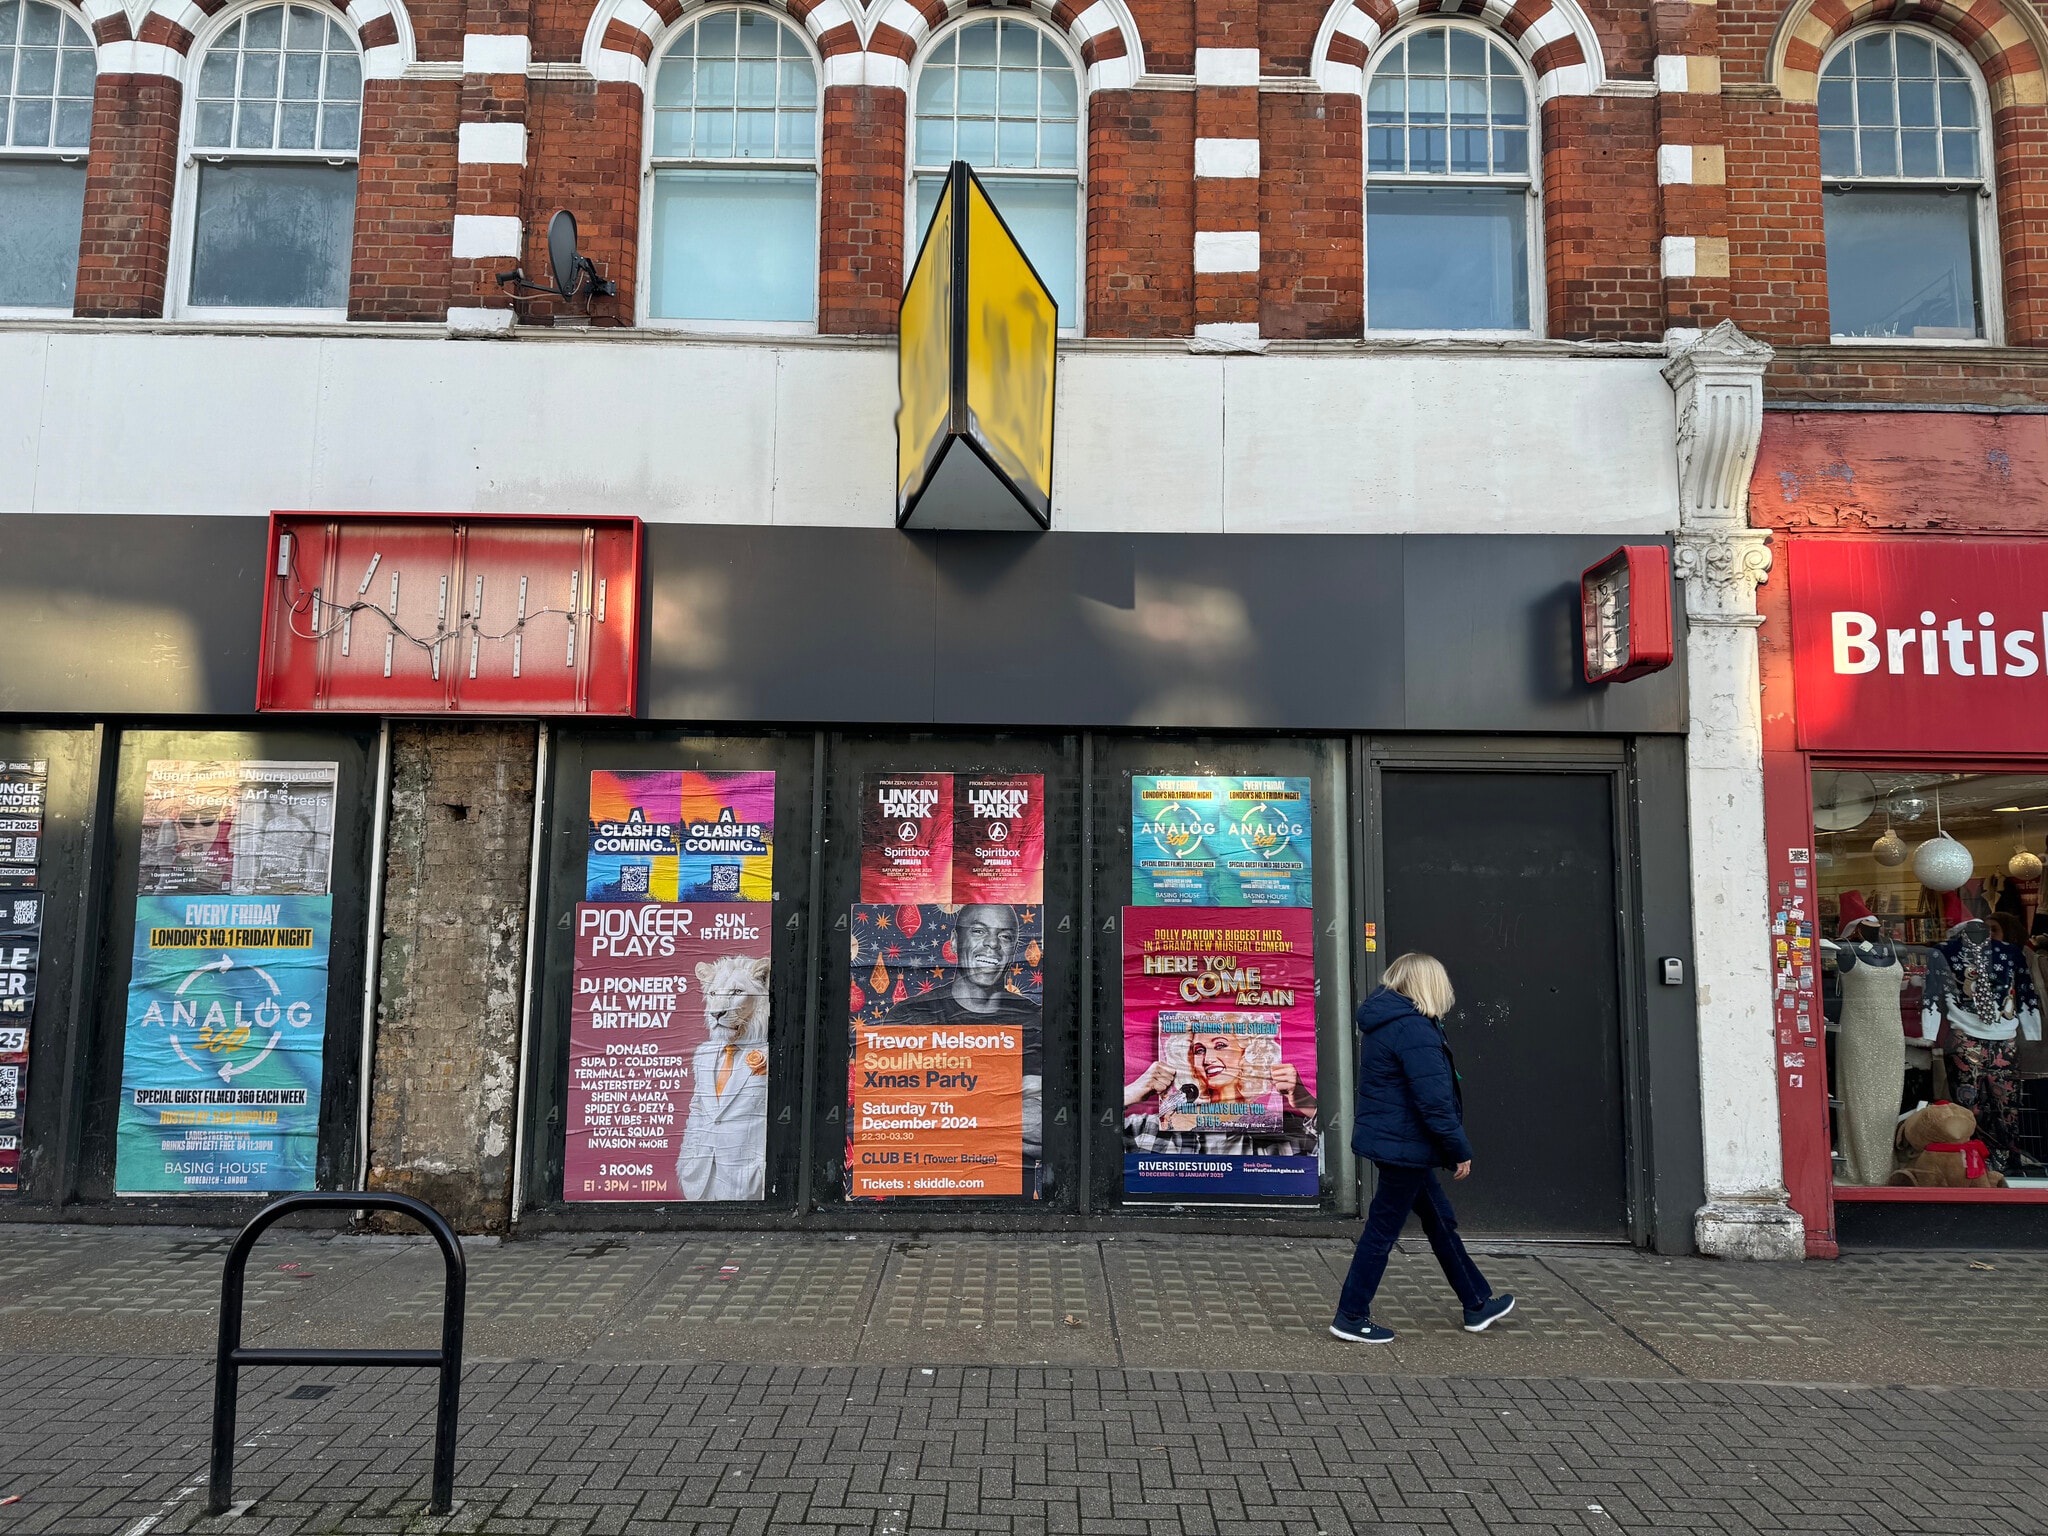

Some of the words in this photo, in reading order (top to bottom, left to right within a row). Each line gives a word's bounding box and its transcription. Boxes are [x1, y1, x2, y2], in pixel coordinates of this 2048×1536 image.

[1831, 611, 2048, 677] Britis
[1157, 780, 1176, 790] EVERY
[1176, 780, 1198, 790] FRIDAY
[1244, 781, 1263, 791] EVERY
[1263, 781, 1285, 791] FRIDAY
[152, 788, 177, 801] Art
[246, 788, 269, 801] Art
[879, 789, 939, 804] LINKIN
[969, 790, 1028, 804] LINKIN
[186, 796, 236, 807] Streets
[279, 796, 328, 807] Streets
[630, 810, 643, 823] A
[720, 810, 732, 823] A
[883, 803, 932, 818] PARK
[973, 803, 1022, 819] PARK
[15, 822, 38, 830] 2025
[600, 825, 653, 837] CLASH
[656, 825, 671, 837] IS
[691, 825, 743, 837] CLASH
[746, 825, 760, 837] IS
[1141, 822, 1216, 835] ANALOG
[1228, 822, 1303, 835] ANALOG
[594, 839, 676, 852] COMING...
[685, 839, 765, 852] COMING...
[884, 847, 930, 859] Spiritbox
[975, 847, 1021, 859] Spiritbox
[185, 904, 230, 925] EVERY
[231, 904, 281, 925] FRIDAY
[715, 913, 746, 928] SUN
[580, 905, 693, 941] PIONEER
[152, 929, 208, 947] LONDON'S
[209, 929, 234, 947] NO.1
[236, 929, 275, 947] FRIDAY
[276, 929, 312, 947] NIGHT
[700, 928, 730, 940] 15TH
[733, 928, 759, 940] DEC
[1155, 929, 1179, 941] DOLLY
[1182, 929, 1223, 941] PARTON'S
[1225, 929, 1260, 941] BIGGEST
[1262, 929, 1282, 941] HITS
[592, 936, 676, 957] PLAYS
[1144, 941, 1152, 951] IN
[1155, 941, 1161, 951] A
[1163, 941, 1191, 951] BRAND
[1194, 941, 1212, 951] NEW
[1215, 941, 1252, 952] MUSICAL
[1255, 942, 1294, 953] COMEDY!
[1144, 955, 1198, 974] HERE
[1203, 956, 1237, 971] YOU
[580, 978, 600, 994] DJ
[604, 976, 688, 993] PIONEER'S
[1180, 967, 1261, 1003] COME
[590, 995, 622, 1011] ALL
[626, 995, 677, 1011] WHITE
[1235, 990, 1295, 1006] AGAIN
[141, 997, 313, 1028] ANALOG
[592, 1012, 672, 1029] BIRTHDAY
[193, 1026, 250, 1053] 360
[864, 1032, 927, 1049] Trevor
[932, 1032, 1015, 1049] Nelson's
[606, 1044, 659, 1056] DONAEO
[581, 1057, 607, 1067] SUPA
[609, 1057, 617, 1067] D
[625, 1057, 682, 1067] COLDSTEPS
[863, 1052, 972, 1070] SoulNation
[574, 1068, 625, 1079] TERMINAL
[628, 1068, 635, 1079] 4
[643, 1068, 688, 1079] WIGMAN
[581, 1080, 652, 1090] MASTERSTEPZ
[659, 1080, 672, 1090] DJ
[674, 1080, 680, 1090] S
[863, 1071, 920, 1088] Xmas
[926, 1071, 978, 1091] Party
[136, 1090, 174, 1104] SPECIAL
[174, 1090, 203, 1104] GUEST
[204, 1090, 235, 1104] FILMED
[237, 1090, 255, 1104] 360
[256, 1090, 279, 1104] EACH
[280, 1090, 305, 1104] WEEK
[591, 1092, 627, 1102] SHENIN
[630, 1092, 669, 1102] AMARA
[584, 1103, 618, 1114] SPIDEY
[622, 1103, 631, 1114] G
[639, 1103, 665, 1114] DEZY
[667, 1103, 675, 1114] B
[862, 1102, 926, 1117] Saturday
[930, 1102, 954, 1114] 7th
[1200, 1103, 1228, 1115] ALWAYS
[1230, 1103, 1248, 1115] LOVE
[1250, 1103, 1265, 1115] YOU
[234, 1111, 278, 1125] SUPPLIER
[584, 1115, 611, 1126] PURE
[614, 1115, 642, 1126] VIBES
[649, 1115, 674, 1126] NWR
[862, 1117, 938, 1130] December
[941, 1117, 978, 1129] 2024
[185, 1131, 208, 1141] LADIES
[593, 1127, 625, 1137] LOYAL
[627, 1127, 665, 1137] SQUAD
[861, 1132, 914, 1141] 22.30-03.30
[162, 1140, 186, 1151] DRINKS
[220, 1140, 235, 1151] FREE
[588, 1138, 636, 1149] INVASION
[861, 1152, 899, 1164] CLUB
[903, 1152, 920, 1164] E1
[923, 1154, 958, 1165] (Tower
[960, 1154, 998, 1165] Bridge)
[165, 1163, 214, 1174] BASING
[220, 1163, 267, 1174] HOUSE
[600, 1164, 607, 1176] 3
[609, 1164, 653, 1176] ROOMS
[1138, 1161, 1233, 1172] RIVERSIDESTUDIOS
[184, 1176, 220, 1185] SHOREDITCH
[224, 1176, 248, 1185] LONDON
[584, 1180, 595, 1192] E1
[604, 1180, 629, 1192] 3PM
[641, 1180, 667, 1192] 11PM
[861, 1178, 904, 1189] Tickets
[914, 1178, 984, 1189] skiddle.com
